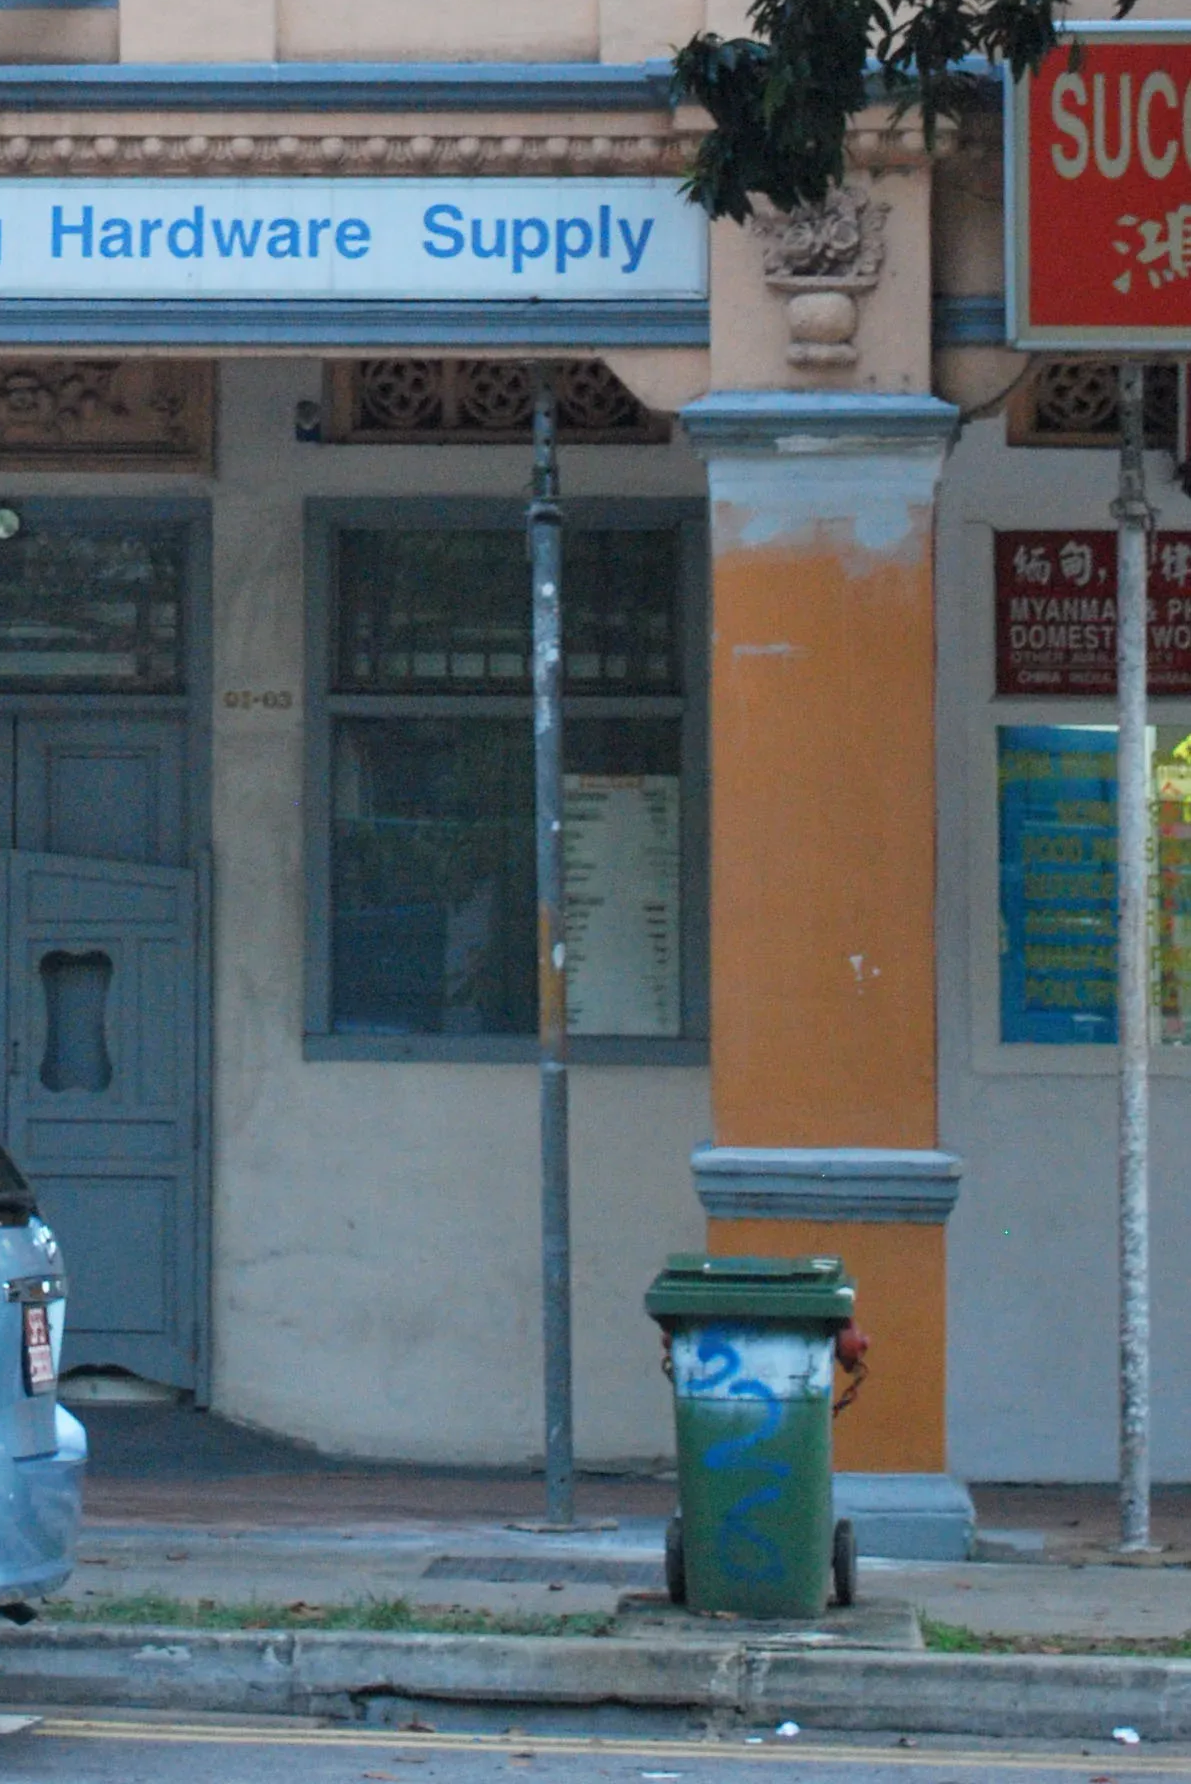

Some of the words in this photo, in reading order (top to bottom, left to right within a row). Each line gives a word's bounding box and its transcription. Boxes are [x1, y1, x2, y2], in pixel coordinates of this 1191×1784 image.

[1051, 71, 1191, 180] SUC
[50, 204, 371, 259] Hardware
[422, 203, 655, 275] Supply
[1010, 598, 1117, 621] MYANMA
[1010, 625, 1116, 650] DOMEST
